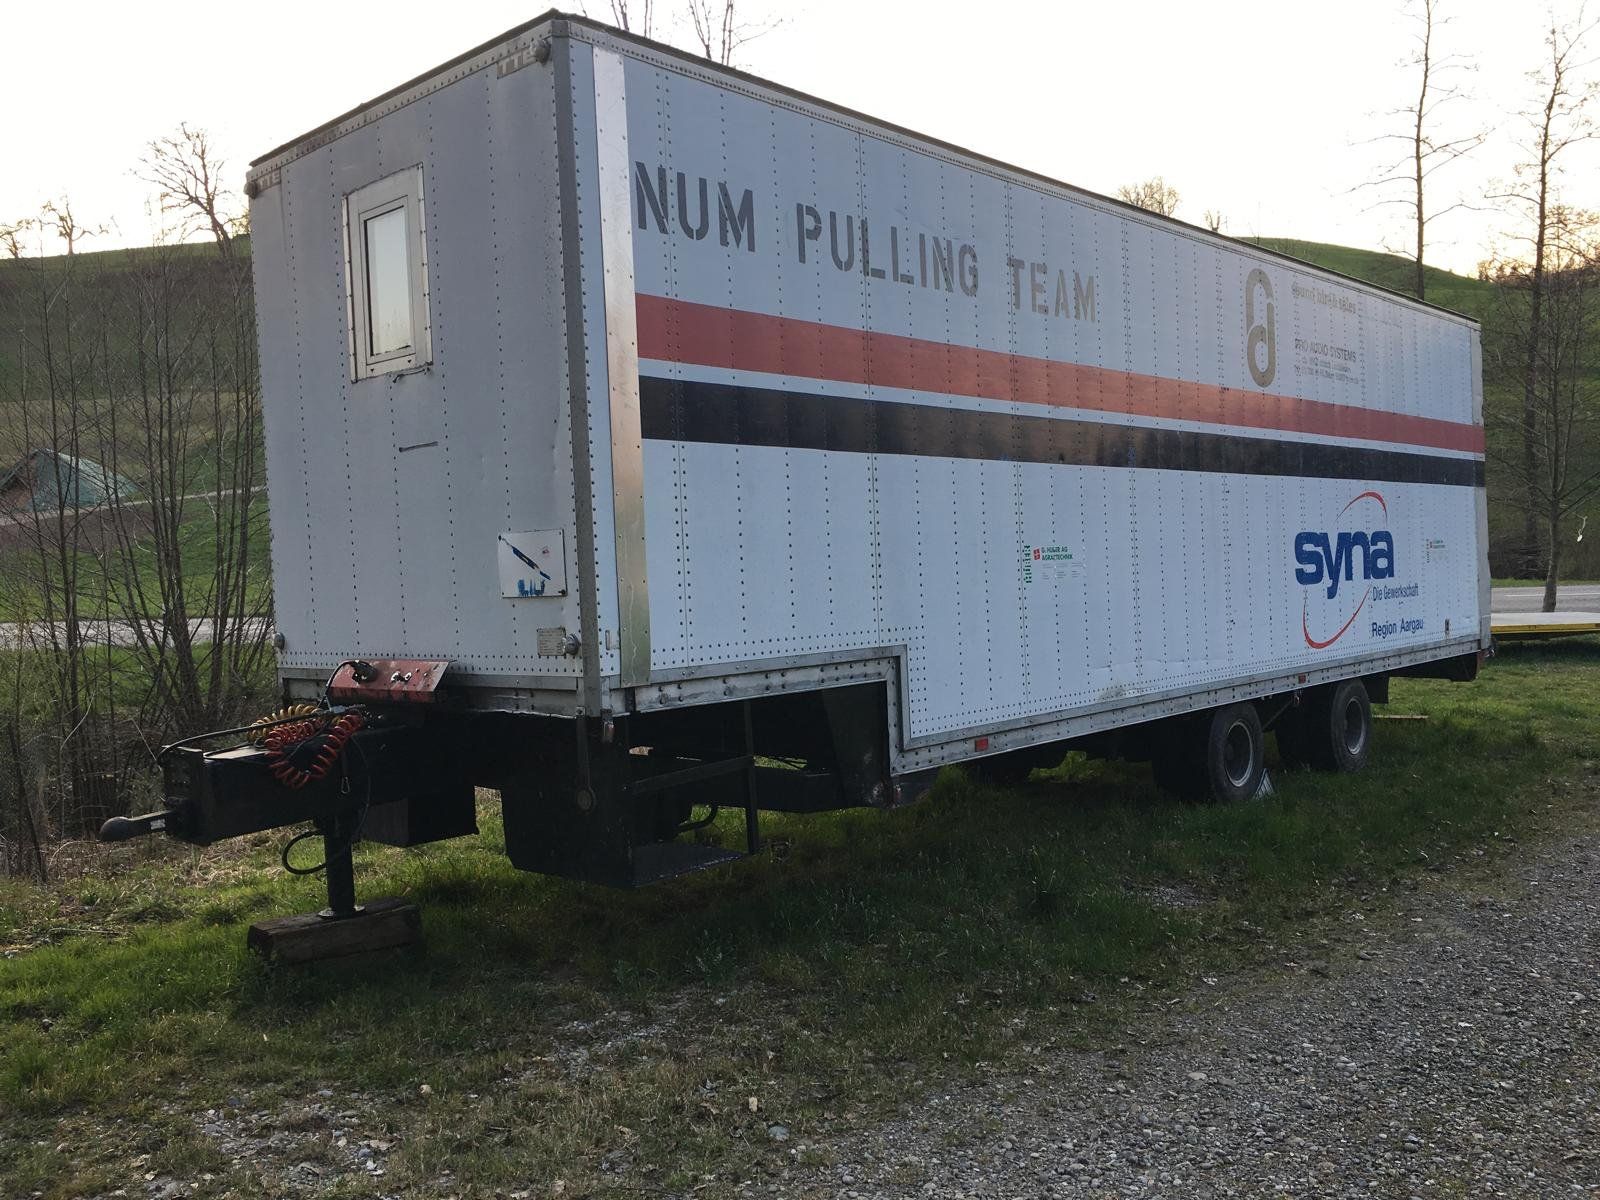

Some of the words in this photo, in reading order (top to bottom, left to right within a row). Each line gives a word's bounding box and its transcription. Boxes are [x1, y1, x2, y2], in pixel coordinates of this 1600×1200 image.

[635, 160, 755, 253] NUM
[796, 202, 979, 298] PULLING
[1007, 256, 1096, 324] TEAM
[1330, 345, 1357, 363] SYSTEMS
[1294, 530, 1395, 600] syna
[1372, 586, 1383, 601] Die
[1384, 583, 1419, 600] Gewerkschaft
[1371, 620, 1397, 639] Region
[1400, 617, 1424, 634] Aargau
